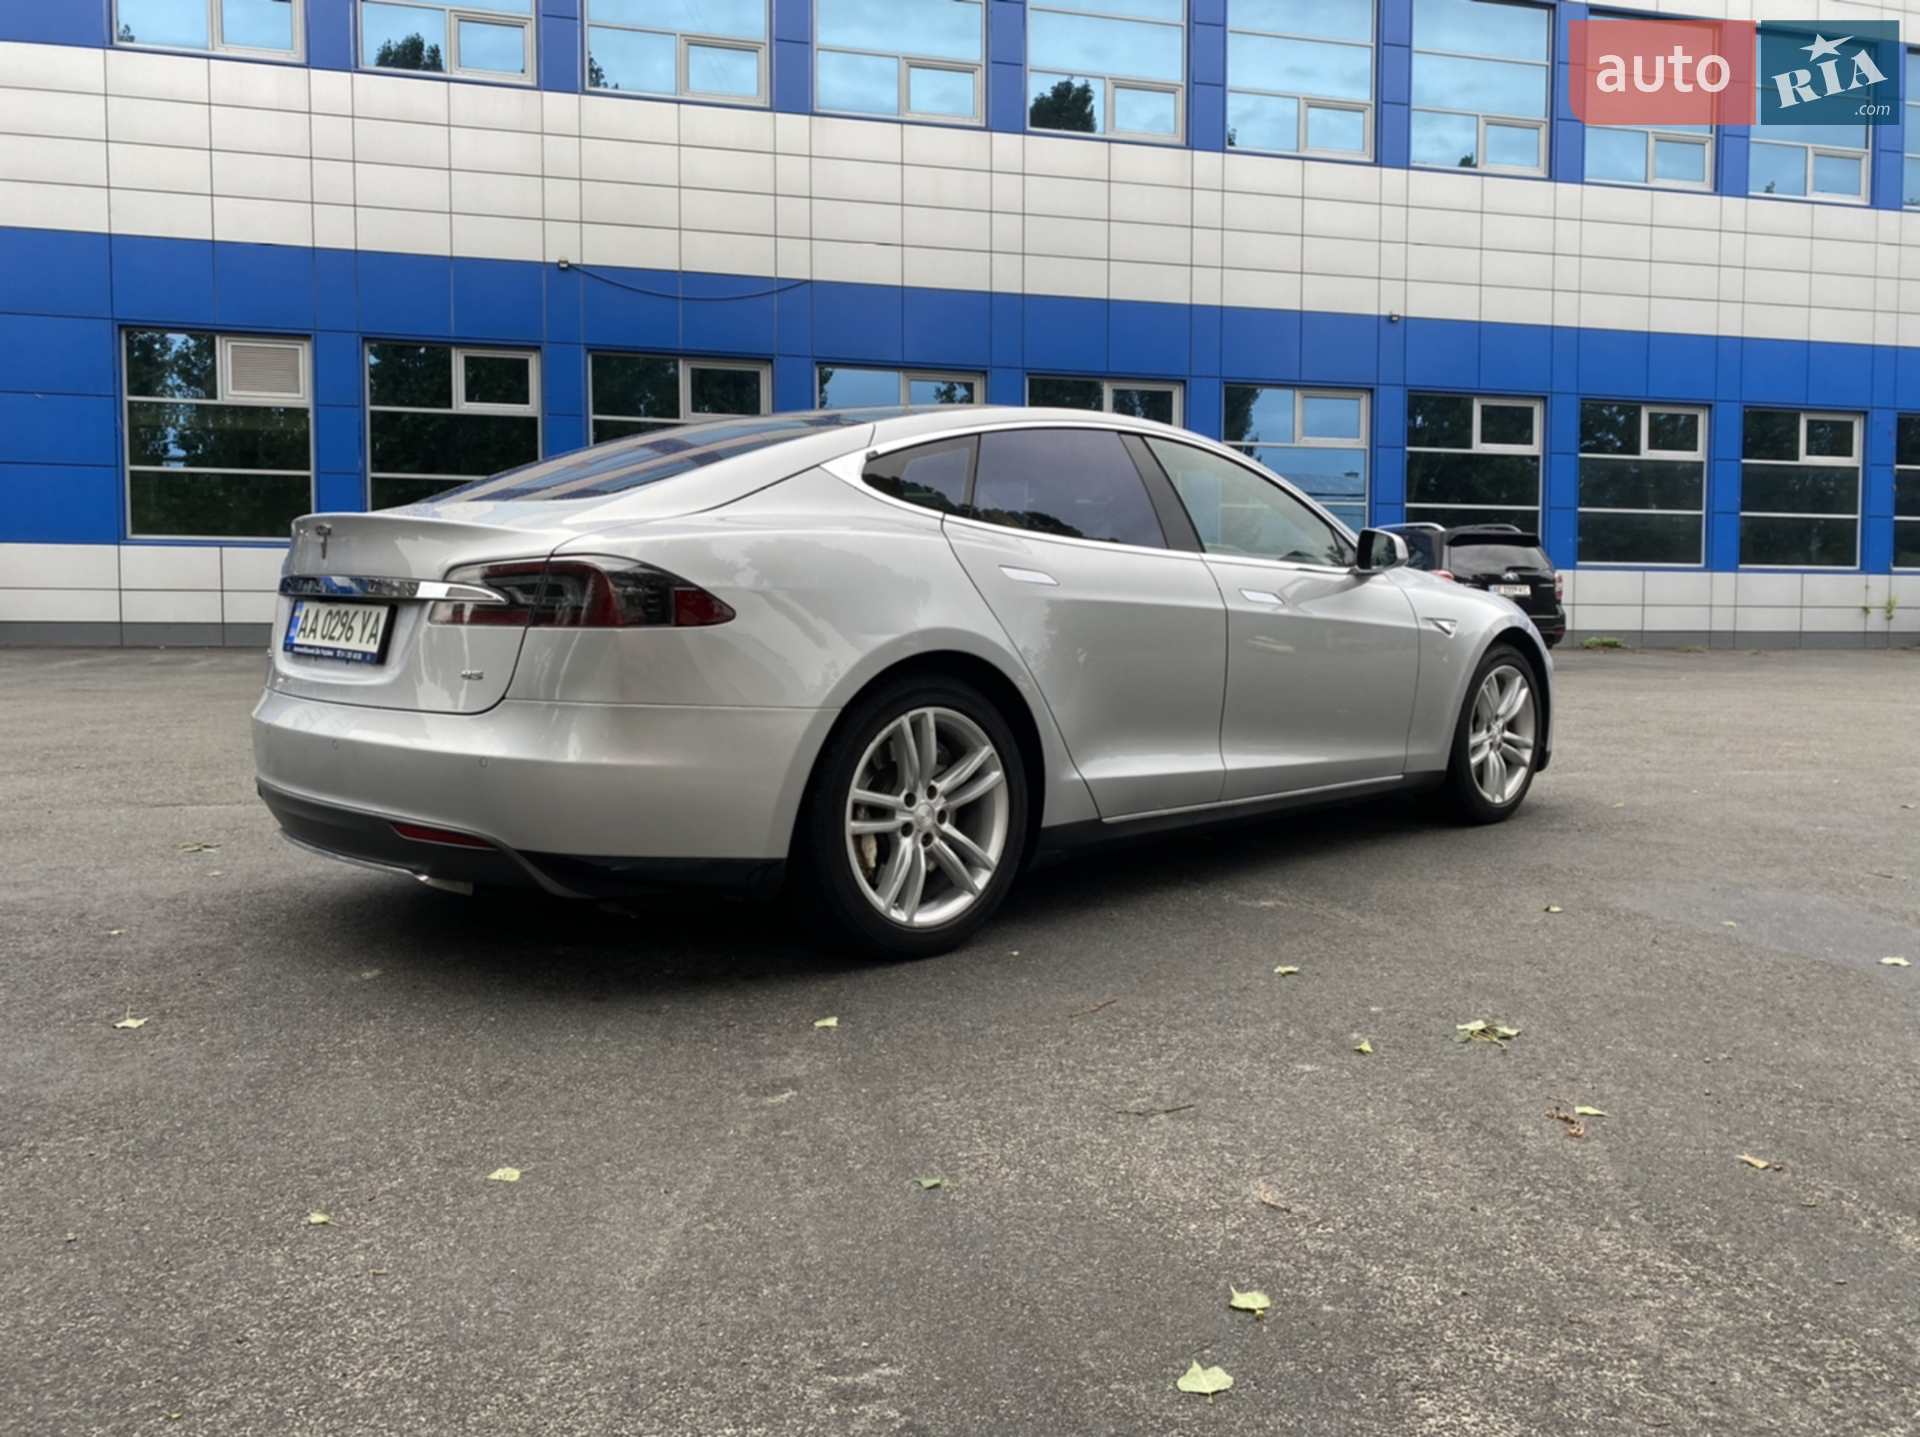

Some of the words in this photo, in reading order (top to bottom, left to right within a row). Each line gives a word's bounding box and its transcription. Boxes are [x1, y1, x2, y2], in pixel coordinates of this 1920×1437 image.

[297, 608, 320, 640] AA
[321, 609, 358, 643] 0296
[359, 610, 381, 646] YA
